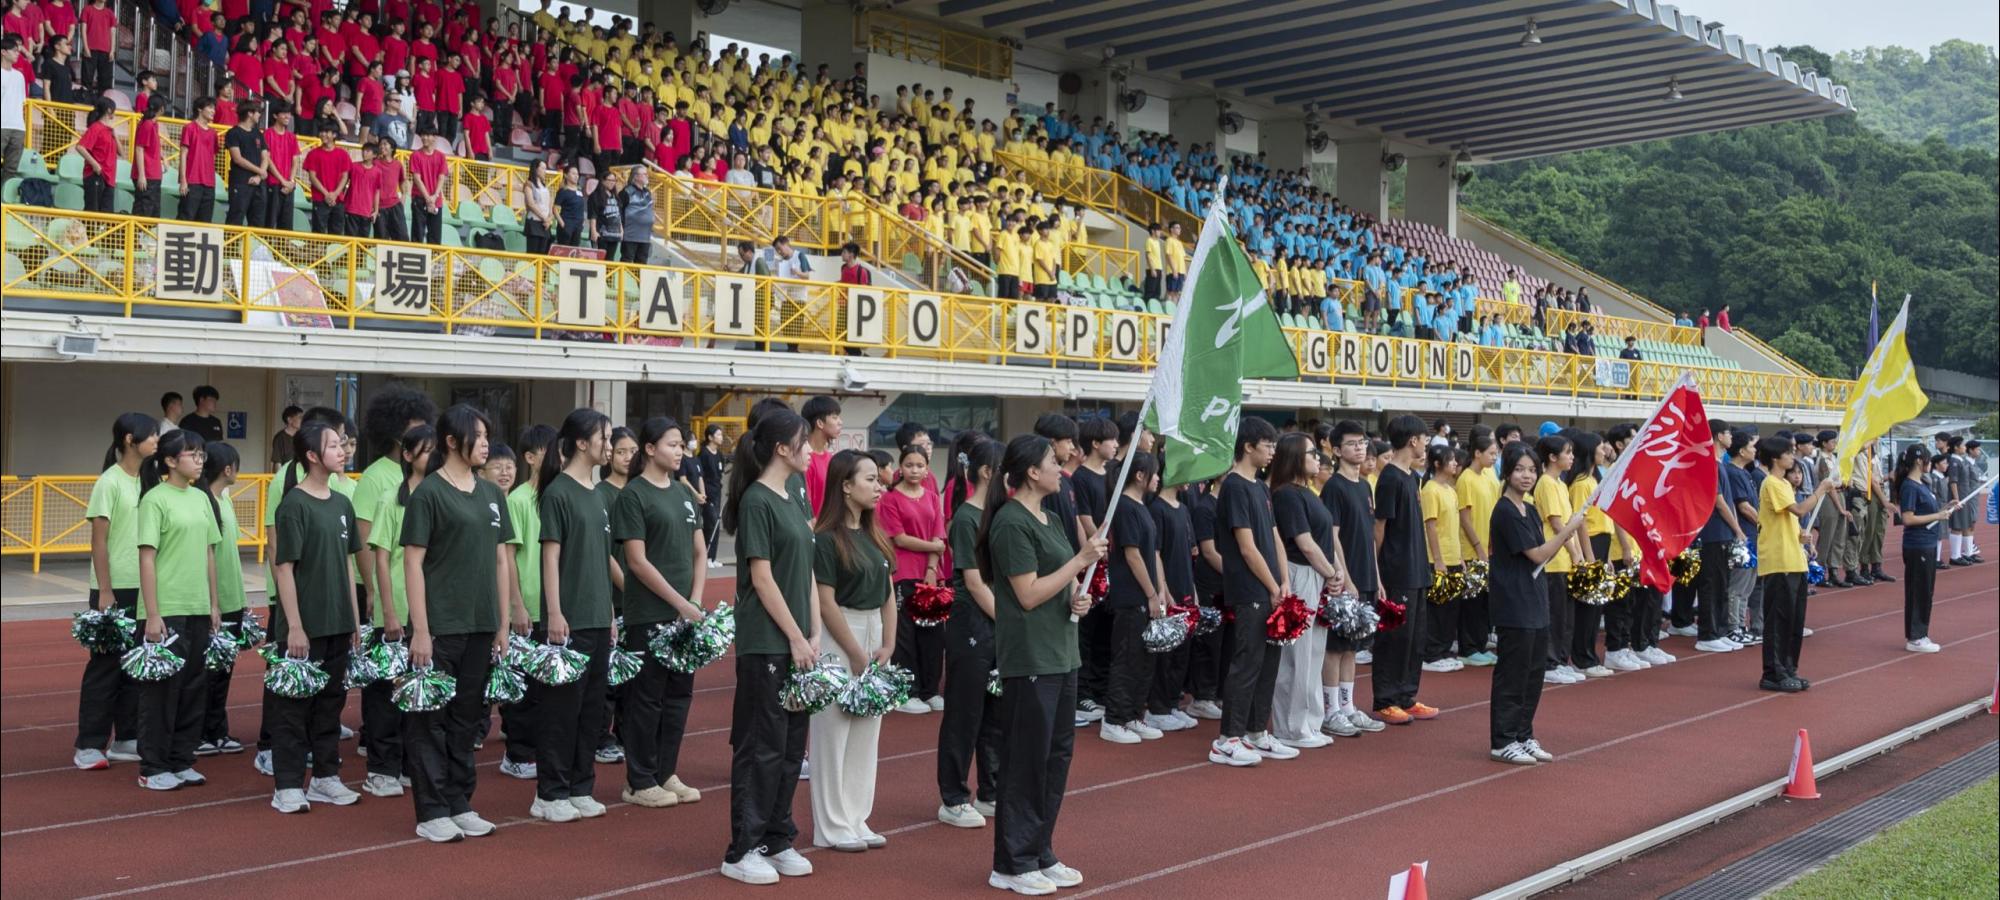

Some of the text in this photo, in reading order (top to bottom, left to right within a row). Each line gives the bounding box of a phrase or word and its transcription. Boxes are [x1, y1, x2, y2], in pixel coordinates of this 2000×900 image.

[569, 268, 742, 329] TAI
[855, 294, 939, 342] PO
[1311, 338, 1472, 378] GROUND
